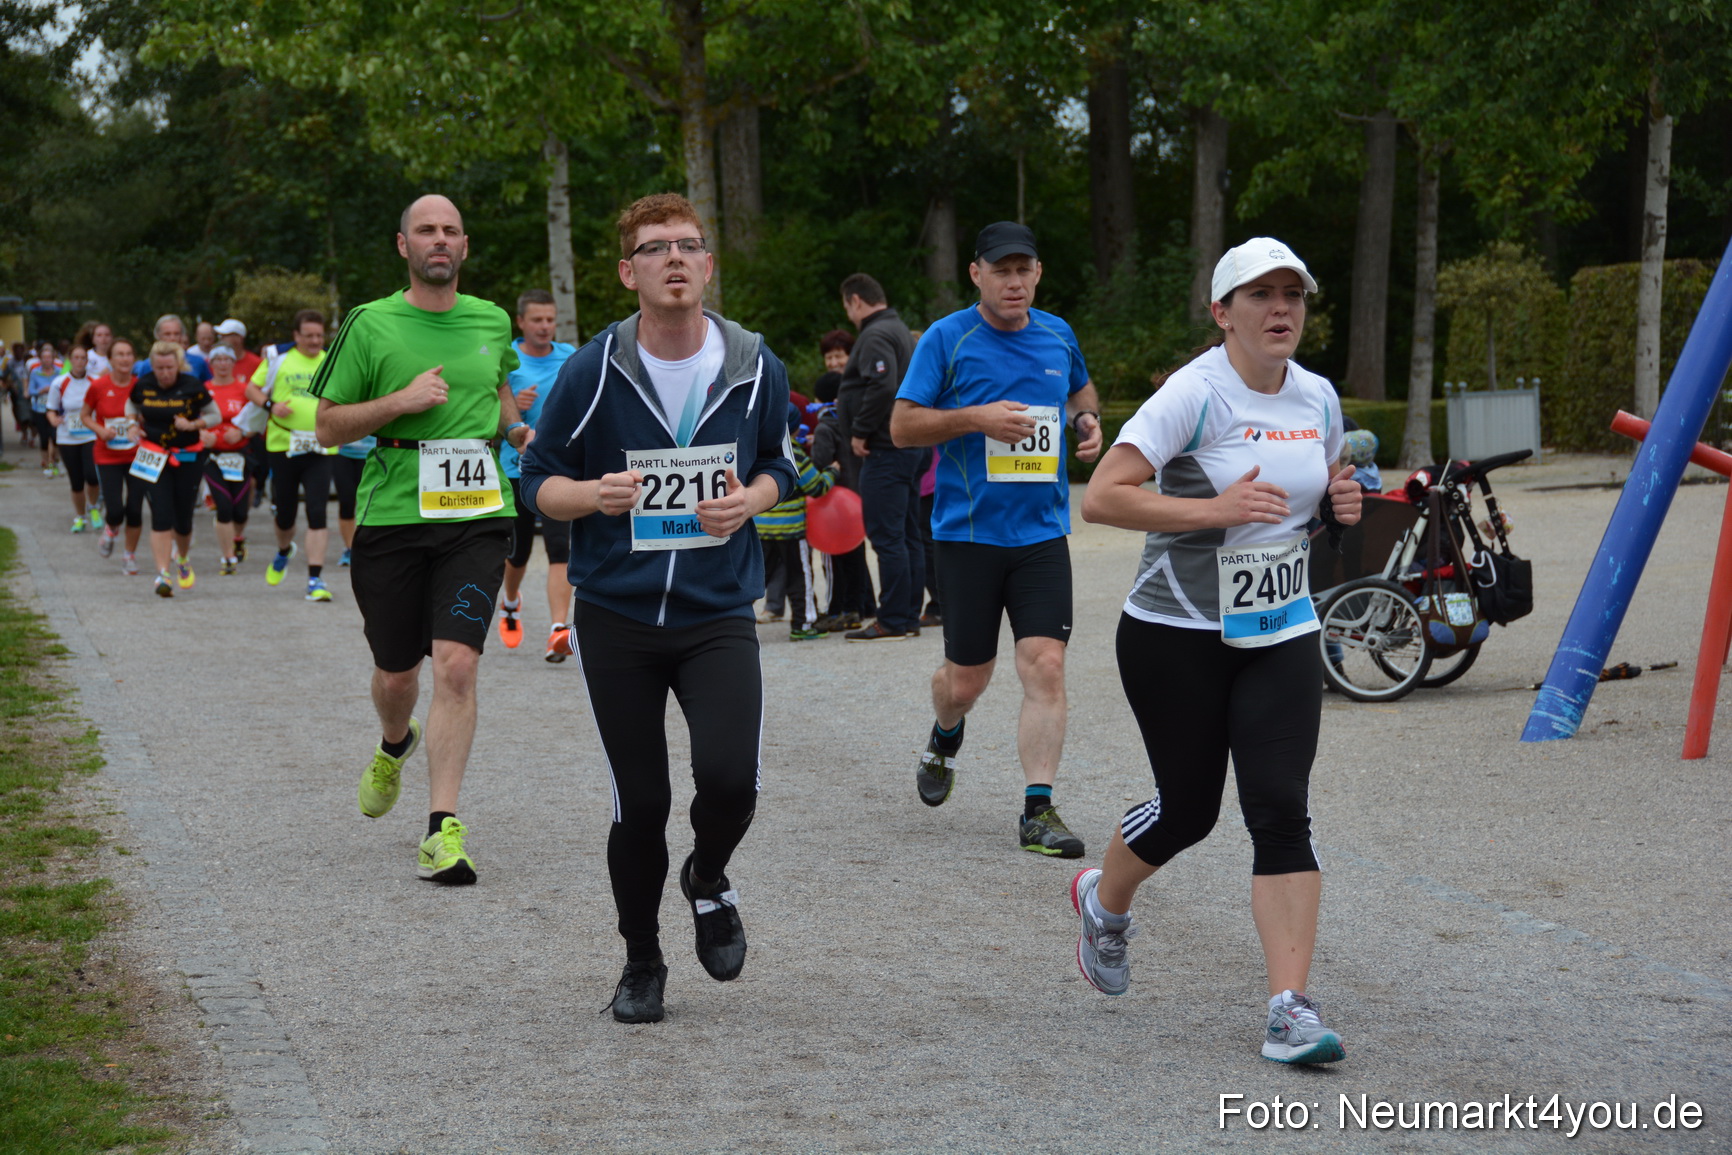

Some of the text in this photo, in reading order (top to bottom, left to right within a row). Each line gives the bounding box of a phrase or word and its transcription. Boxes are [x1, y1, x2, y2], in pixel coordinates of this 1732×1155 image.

[1265, 428, 1322, 441] KLEBL
[421, 447, 450, 455] PARTL
[630, 455, 721, 469] PARTL Neumarkt
[1014, 459, 1042, 471] Franz
[438, 459, 487, 488] 144
[641, 469, 728, 511] 2216
[439, 495, 485, 507] Christian
[662, 519, 703, 535] Marku
[1220, 553, 1259, 566] PARTL
[1232, 557, 1304, 608] 2400
[1259, 610, 1288, 631] Birgit
